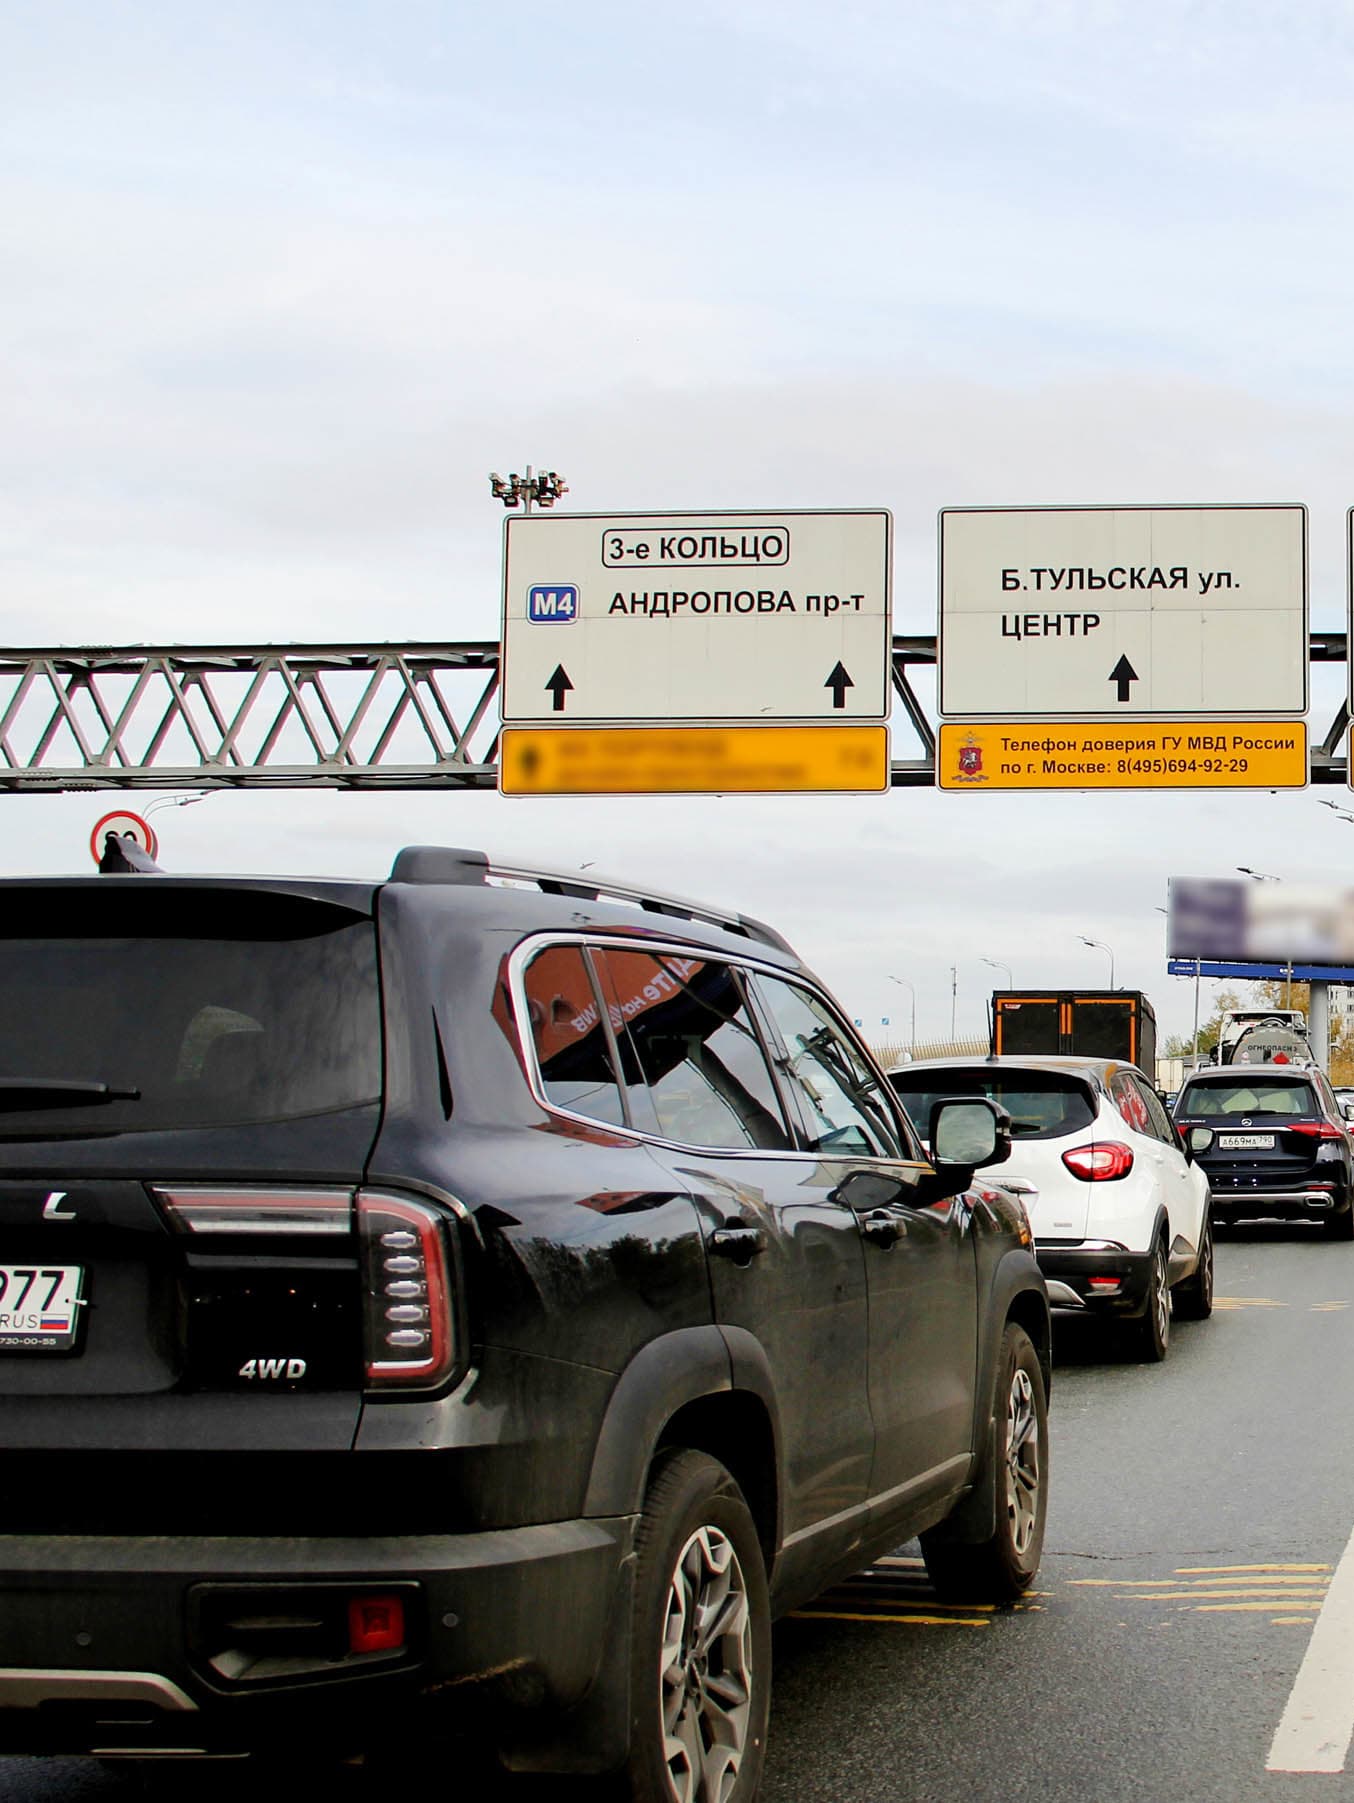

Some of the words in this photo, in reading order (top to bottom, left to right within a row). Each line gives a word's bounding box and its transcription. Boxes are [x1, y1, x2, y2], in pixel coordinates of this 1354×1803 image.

[609, 538, 650, 560] 3-е
[660, 535, 783, 562] КОЛЬЦО
[1001, 567, 1189, 591] Б.ТУЛЬСКАЯ
[1198, 571, 1241, 595] ул.
[533, 592, 574, 616] М4
[608, 590, 797, 619] АНДРОПОВА
[805, 593, 866, 617] пр-т
[1001, 613, 1101, 641] ЦЕНТР
[1000, 737, 1077, 754] Телефон
[1082, 738, 1156, 754] доверия
[1161, 736, 1183, 751] ГУ
[1187, 736, 1228, 753] МВД
[1232, 735, 1296, 751] России
[1000, 762, 1021, 774] по
[1026, 762, 1037, 774] г.
[1042, 759, 1111, 774] Москве:
[1116, 758, 1249, 775] 8(495)694-92-29
[238, 1359, 307, 1379] 4WD
